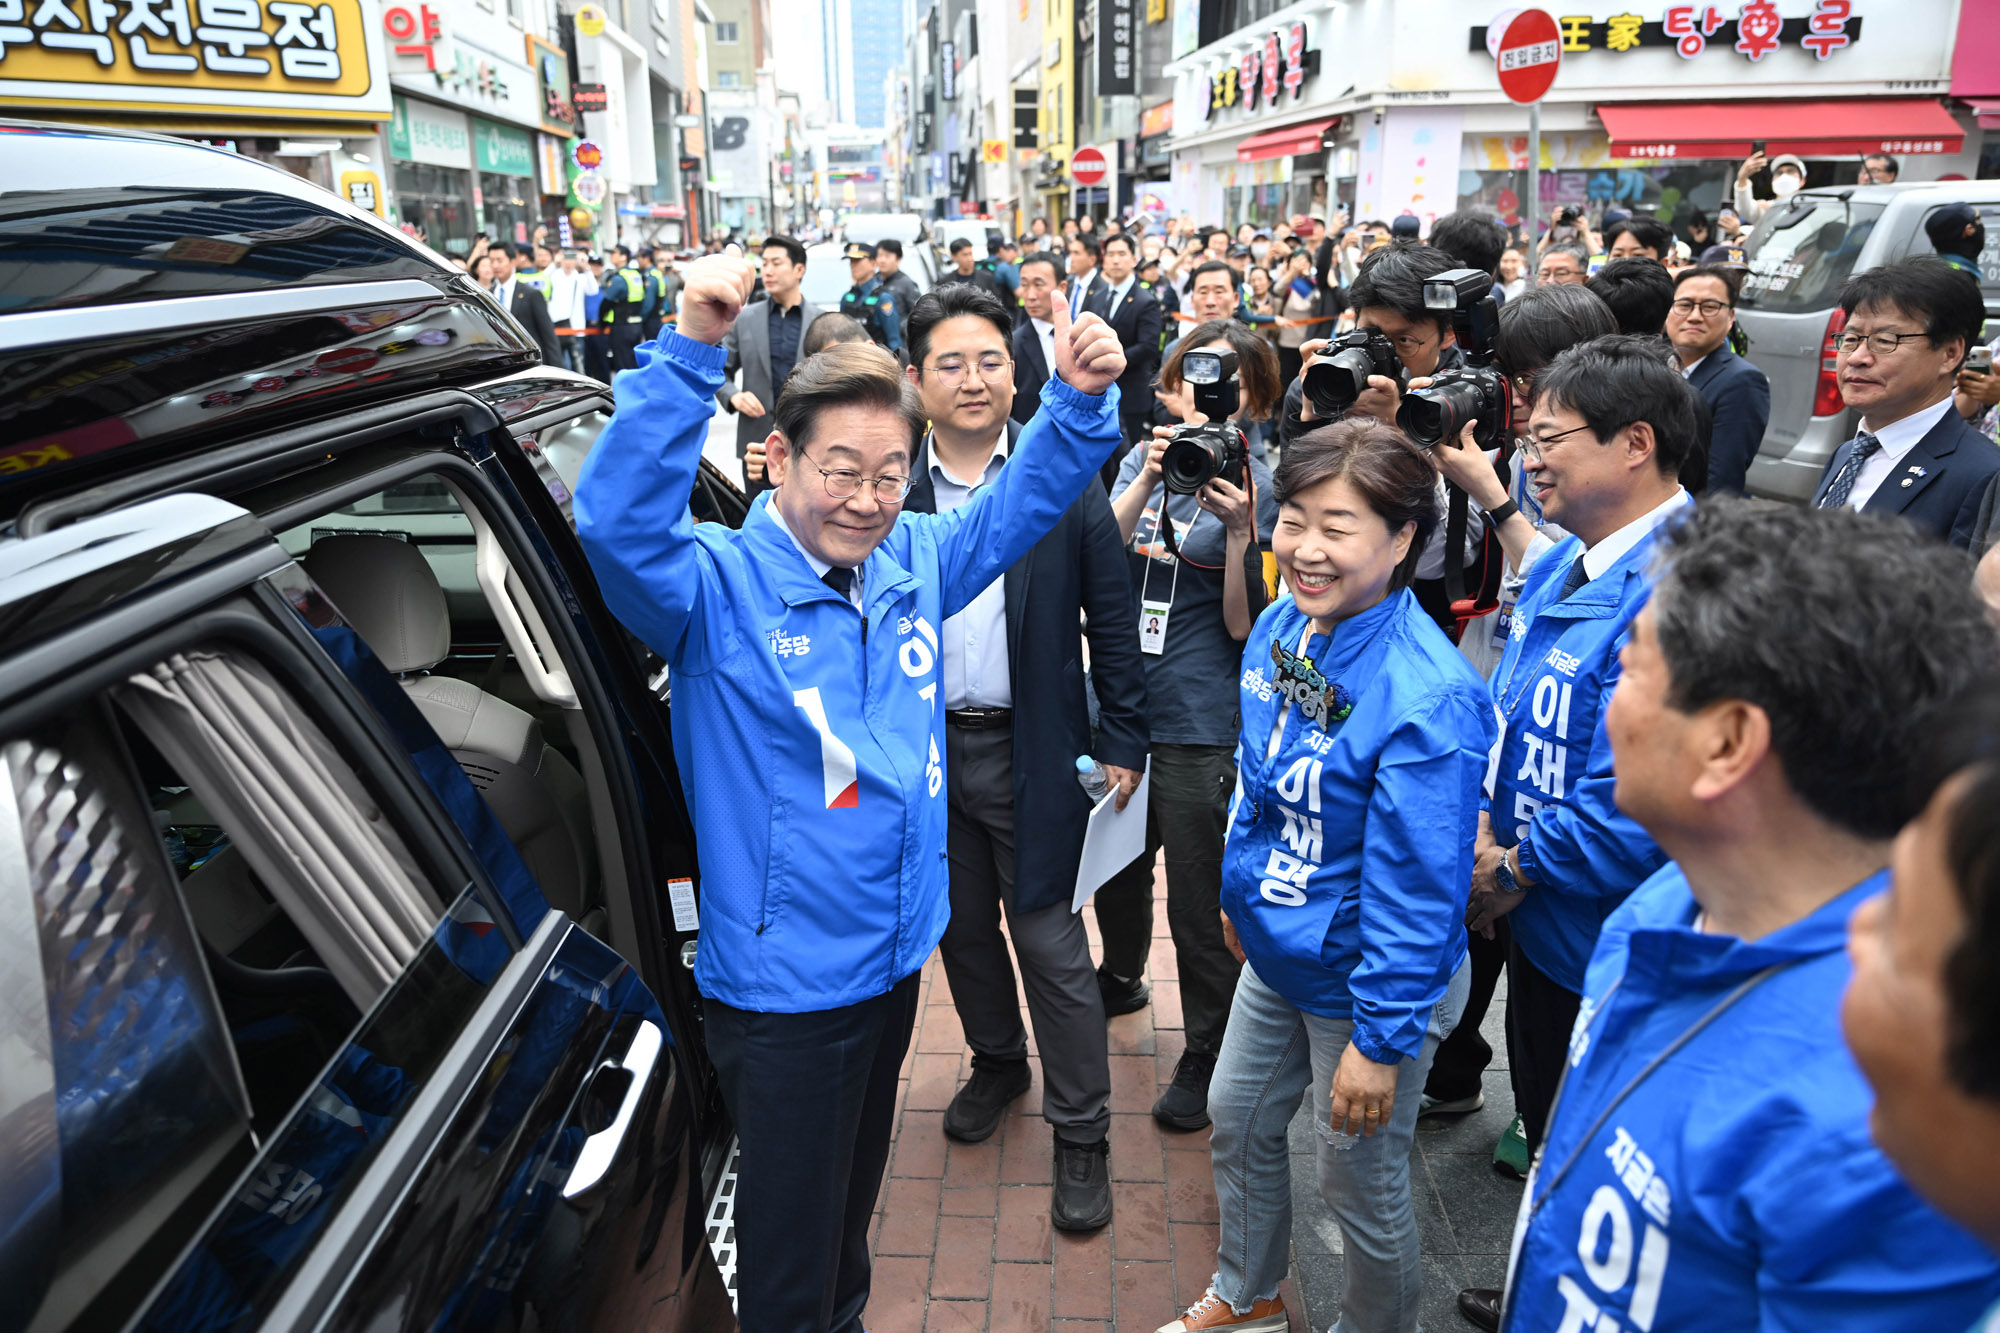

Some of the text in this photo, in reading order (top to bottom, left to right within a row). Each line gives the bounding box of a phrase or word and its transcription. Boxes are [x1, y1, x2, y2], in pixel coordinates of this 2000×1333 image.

[383, 4, 442, 71] 약
[1504, 43, 1555, 68] 진입금지
[1664, 0, 1851, 61] 탕후루
[1546, 647, 1581, 678] 지금은
[1259, 756, 1325, 907] 이재명
[1605, 1126, 1671, 1228] 지금은
